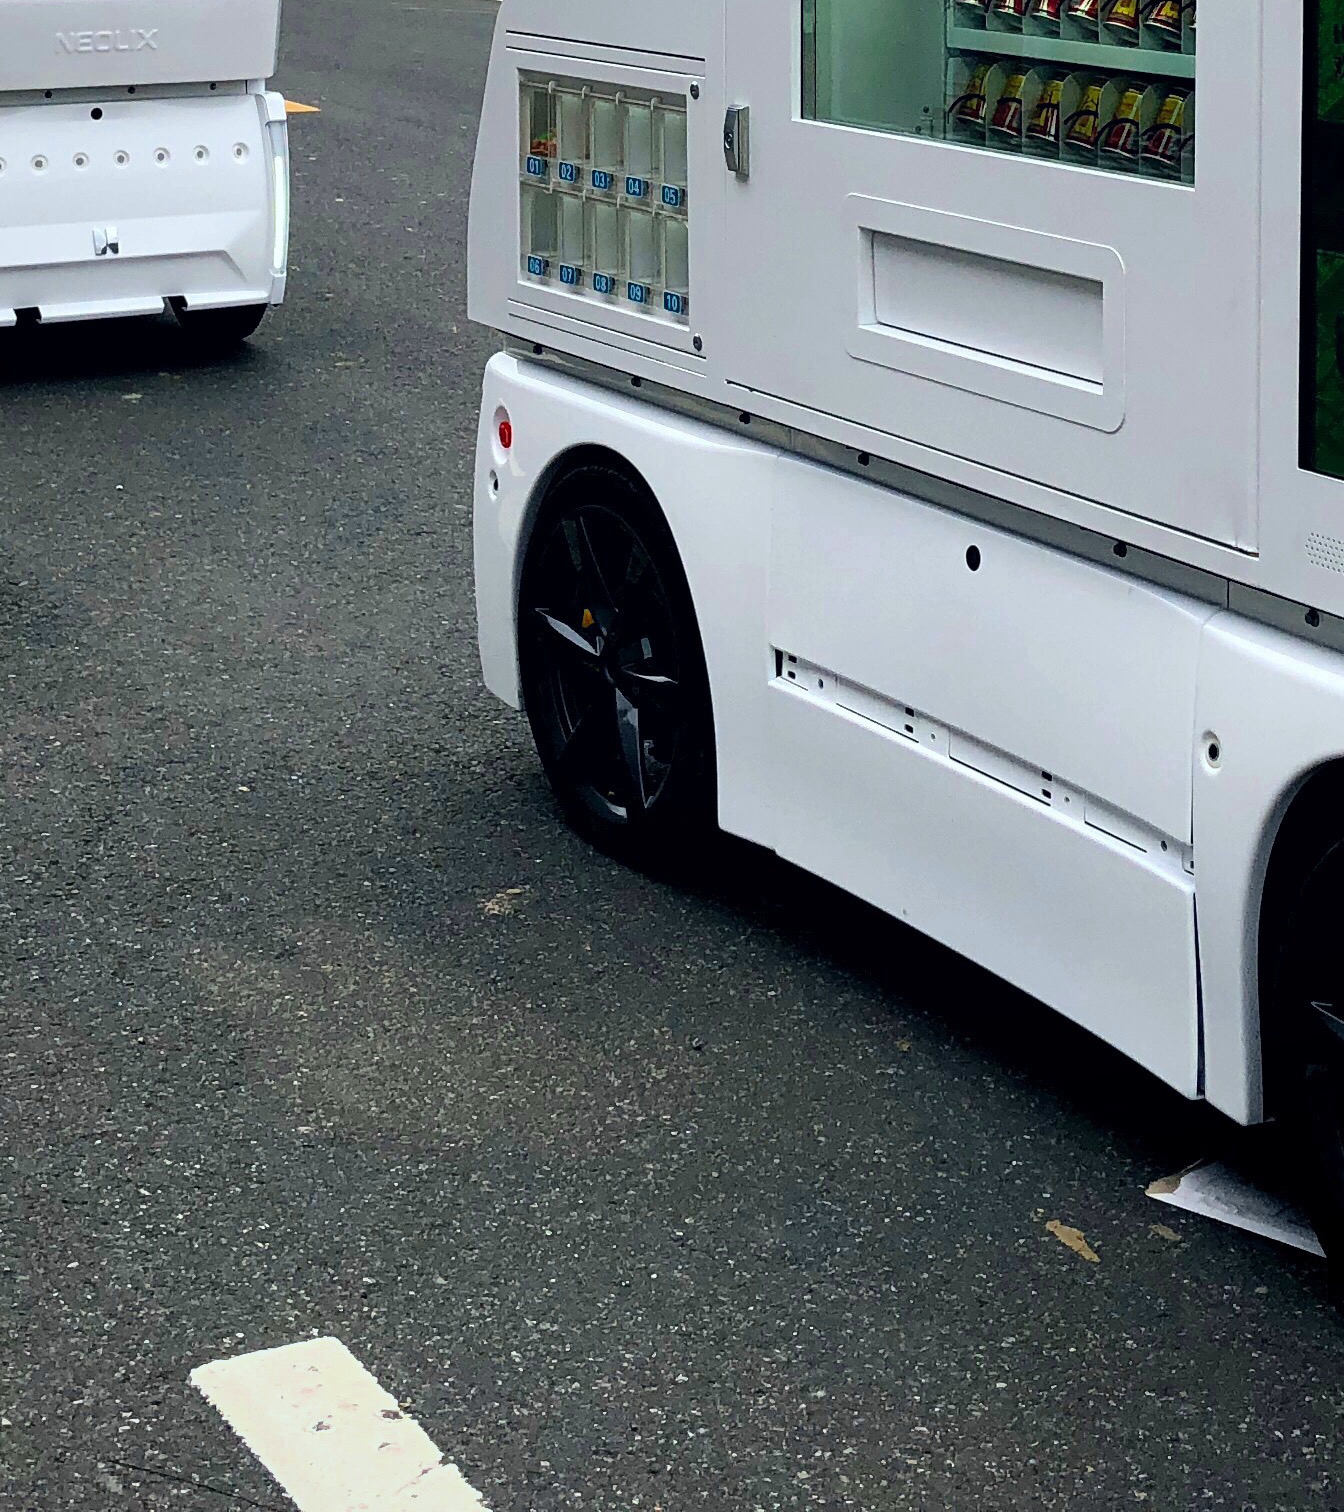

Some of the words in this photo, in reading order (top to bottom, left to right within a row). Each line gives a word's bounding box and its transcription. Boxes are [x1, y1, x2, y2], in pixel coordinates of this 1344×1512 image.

[55, 29, 158, 54] NEOLIX
[529, 158, 539, 173] 01
[561, 165, 572, 180] 02
[594, 173, 605, 188] 03
[628, 179, 639, 194] 04
[664, 188, 676, 204] 05
[561, 268, 572, 282] 07
[595, 277, 606, 292] 08
[630, 285, 641, 300] 09
[666, 295, 677, 310] 10
